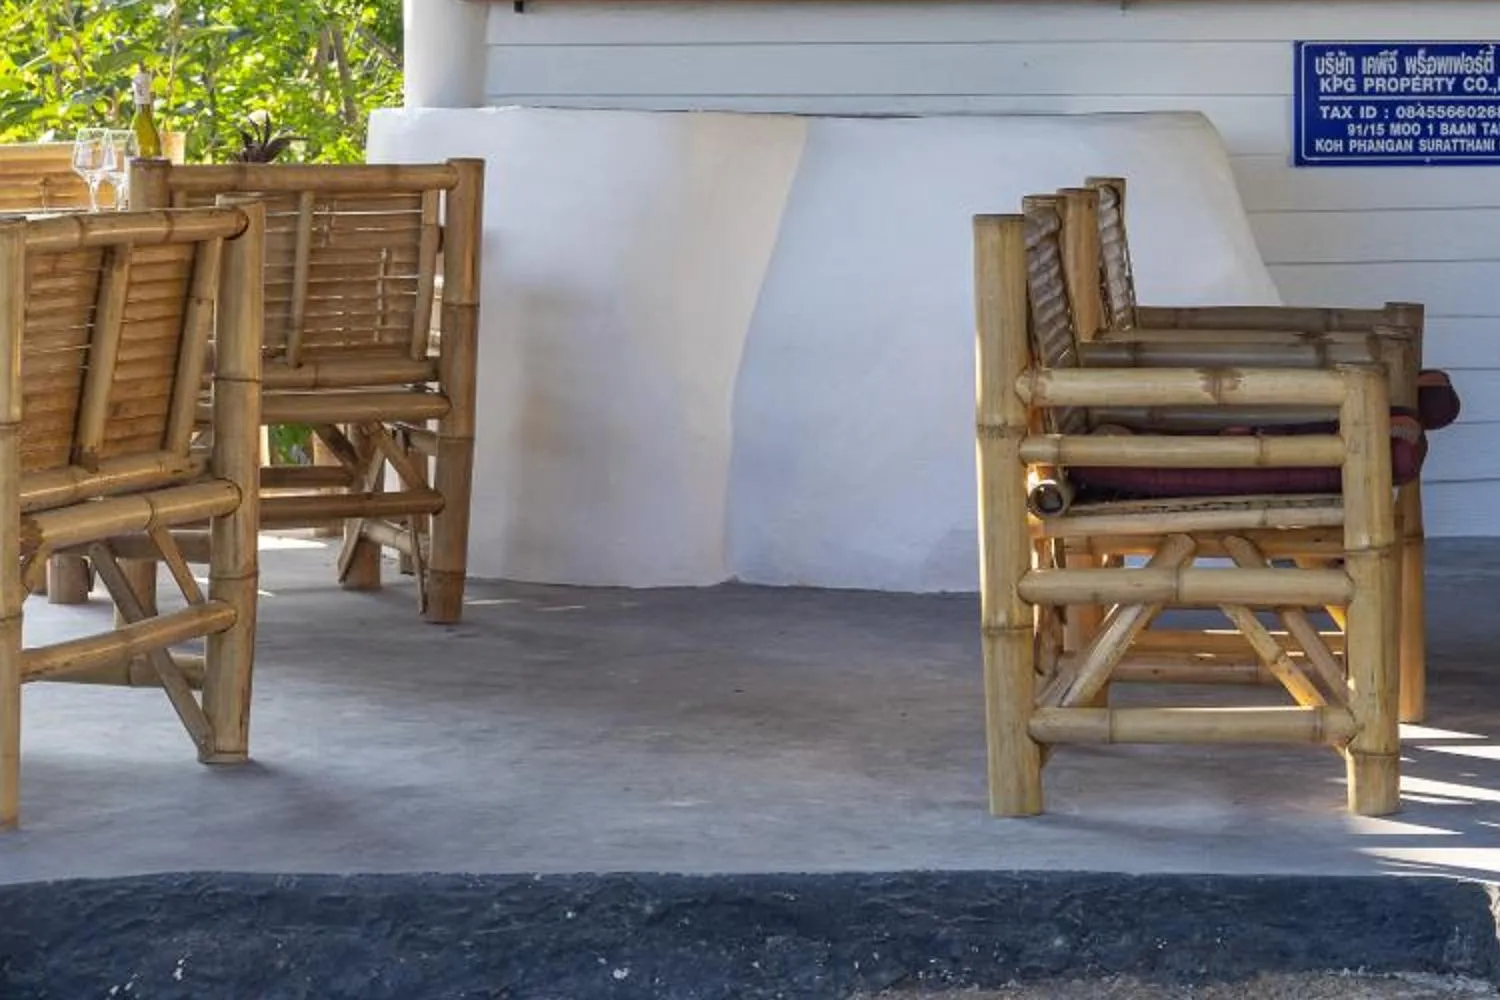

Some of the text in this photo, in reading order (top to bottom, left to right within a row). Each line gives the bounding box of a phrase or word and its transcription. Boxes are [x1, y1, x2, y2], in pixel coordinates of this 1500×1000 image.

[1315, 51, 1355, 75] บริษัท
[1320, 77, 1356, 92] KPG
[1363, 77, 1457, 92] PROPERTY
[1320, 105, 1353, 119] TAX
[1360, 105, 1377, 119] ID
[1347, 123, 1385, 137] 91/15
[1390, 123, 1421, 137] MOO
[1427, 123, 1434, 137] 1
[1440, 123, 1477, 137] BAAN
[1315, 139, 1343, 153] KOH
[1349, 139, 1413, 153] PHANGAN
[1419, 139, 1495, 153] SURATTHANI
